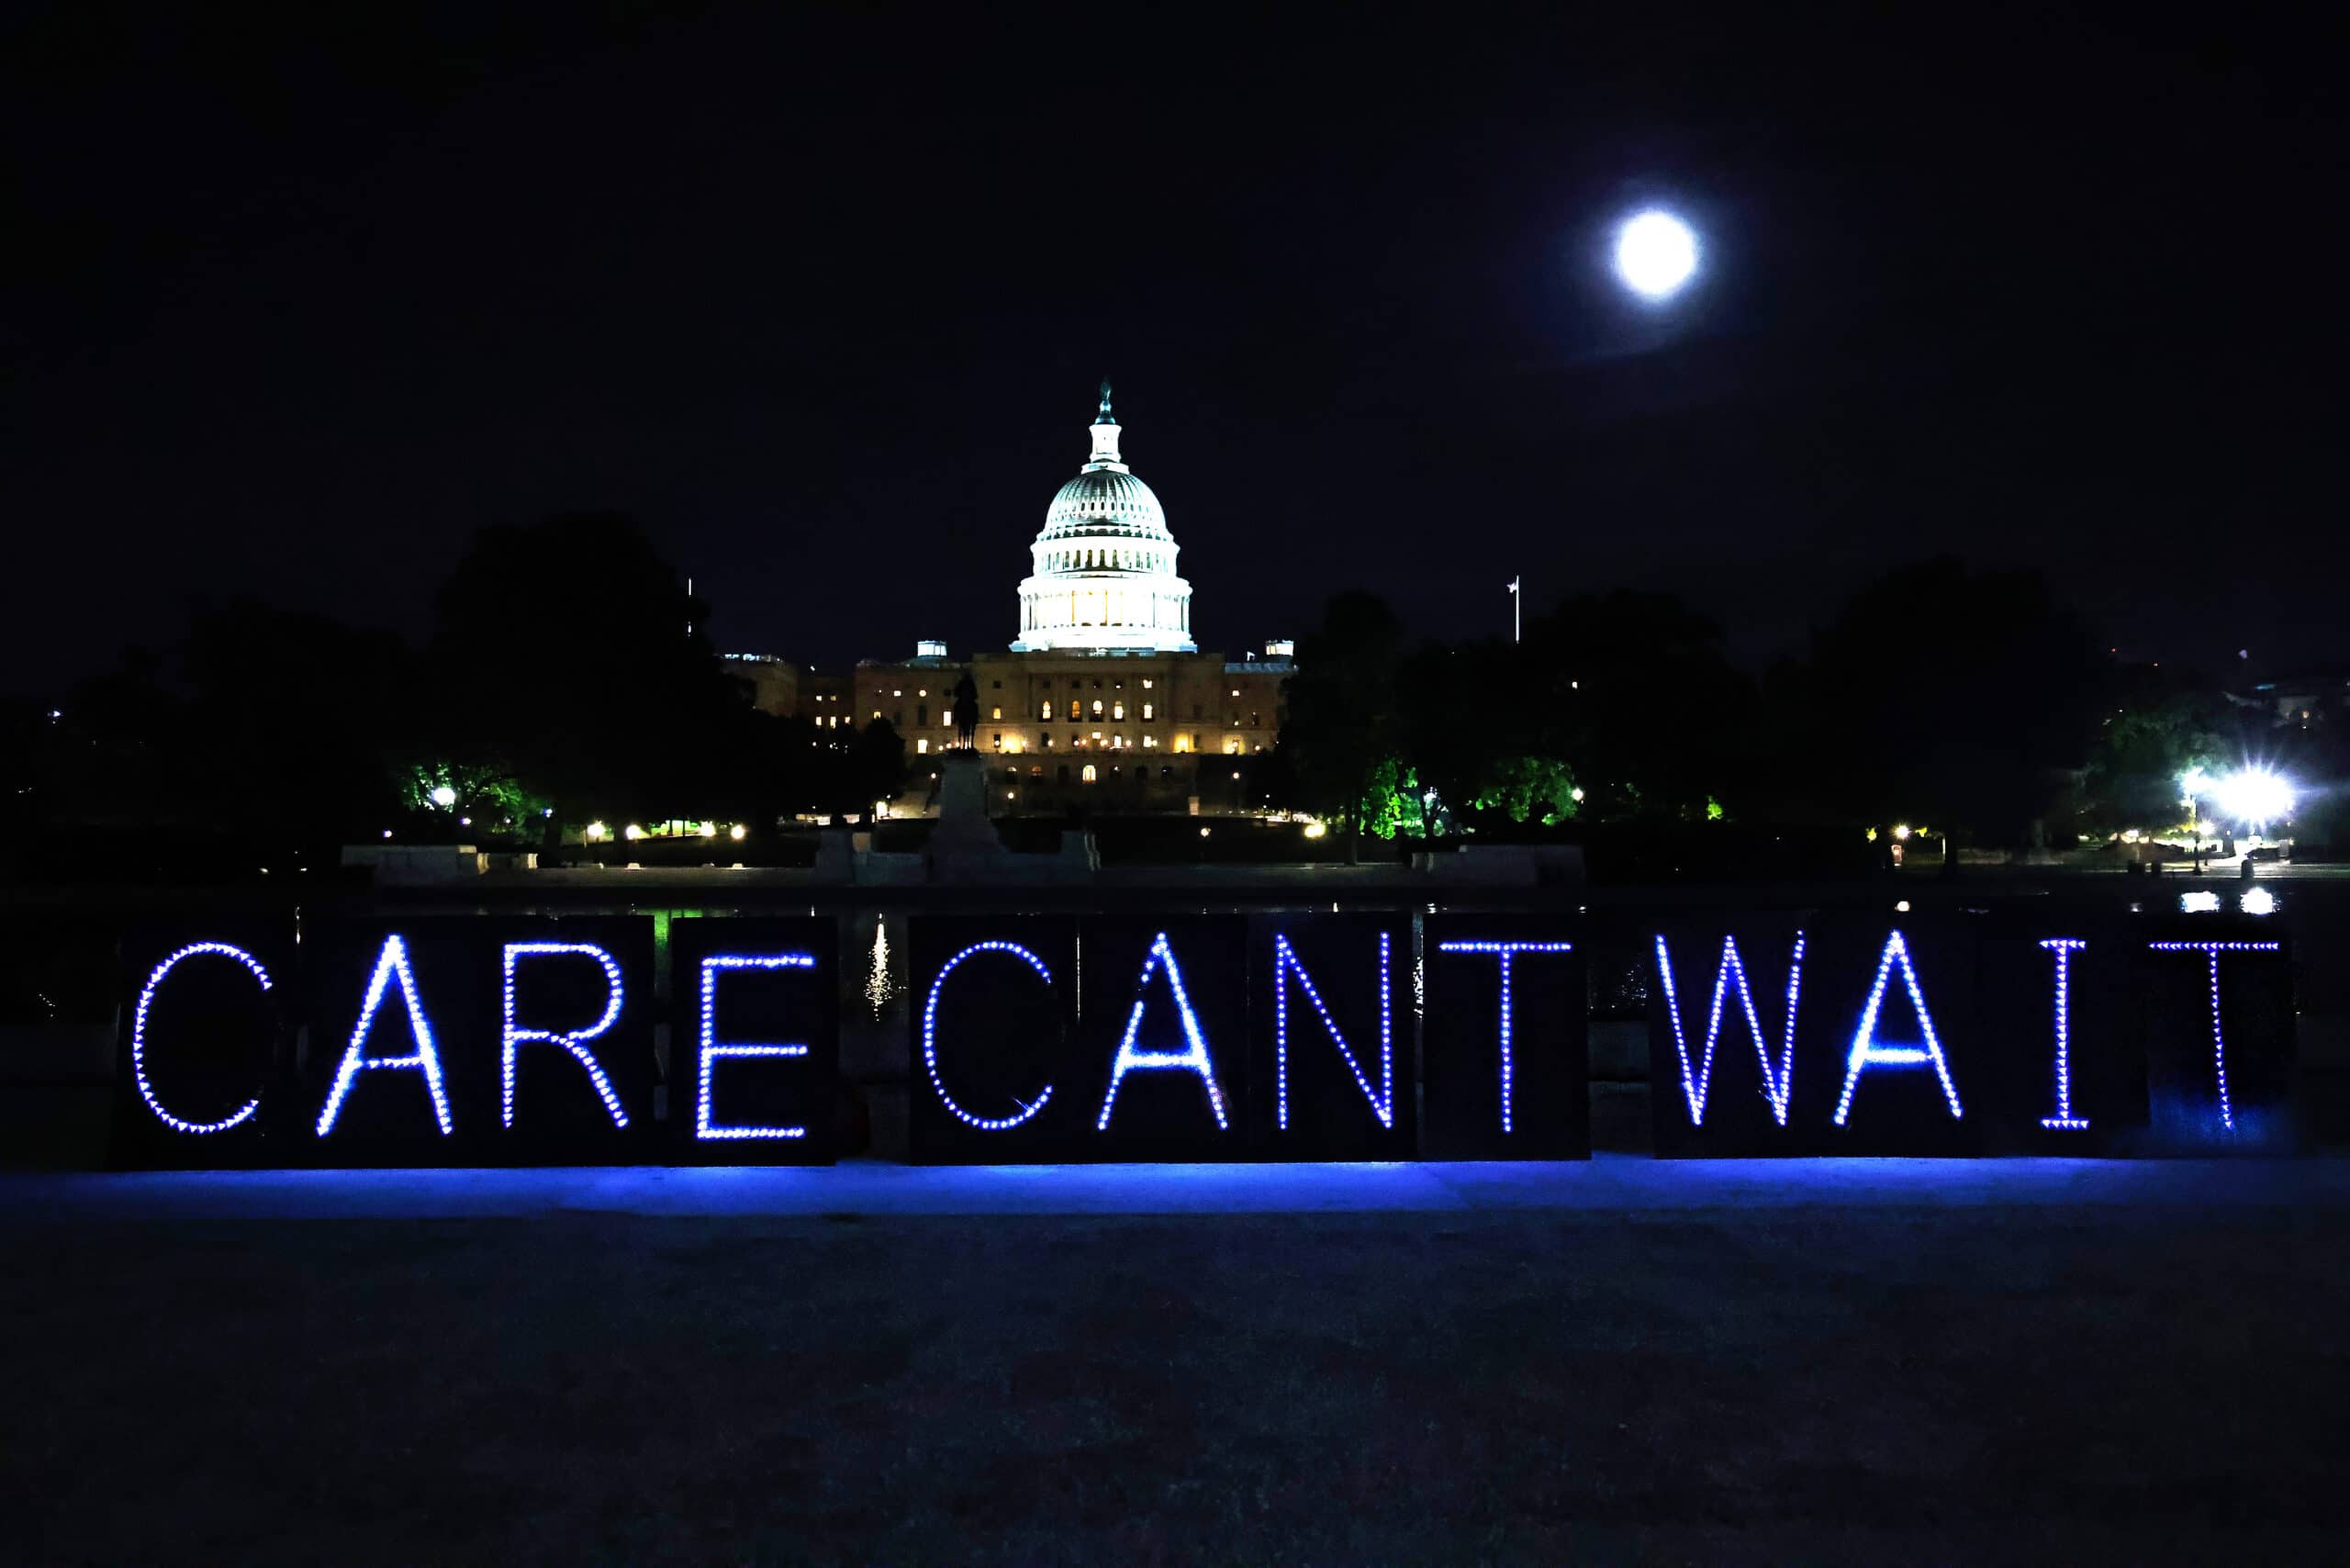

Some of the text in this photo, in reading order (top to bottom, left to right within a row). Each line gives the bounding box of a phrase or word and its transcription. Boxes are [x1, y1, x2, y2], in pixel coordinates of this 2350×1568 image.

[131, 928, 2280, 1141] CARE CANT WAIT
